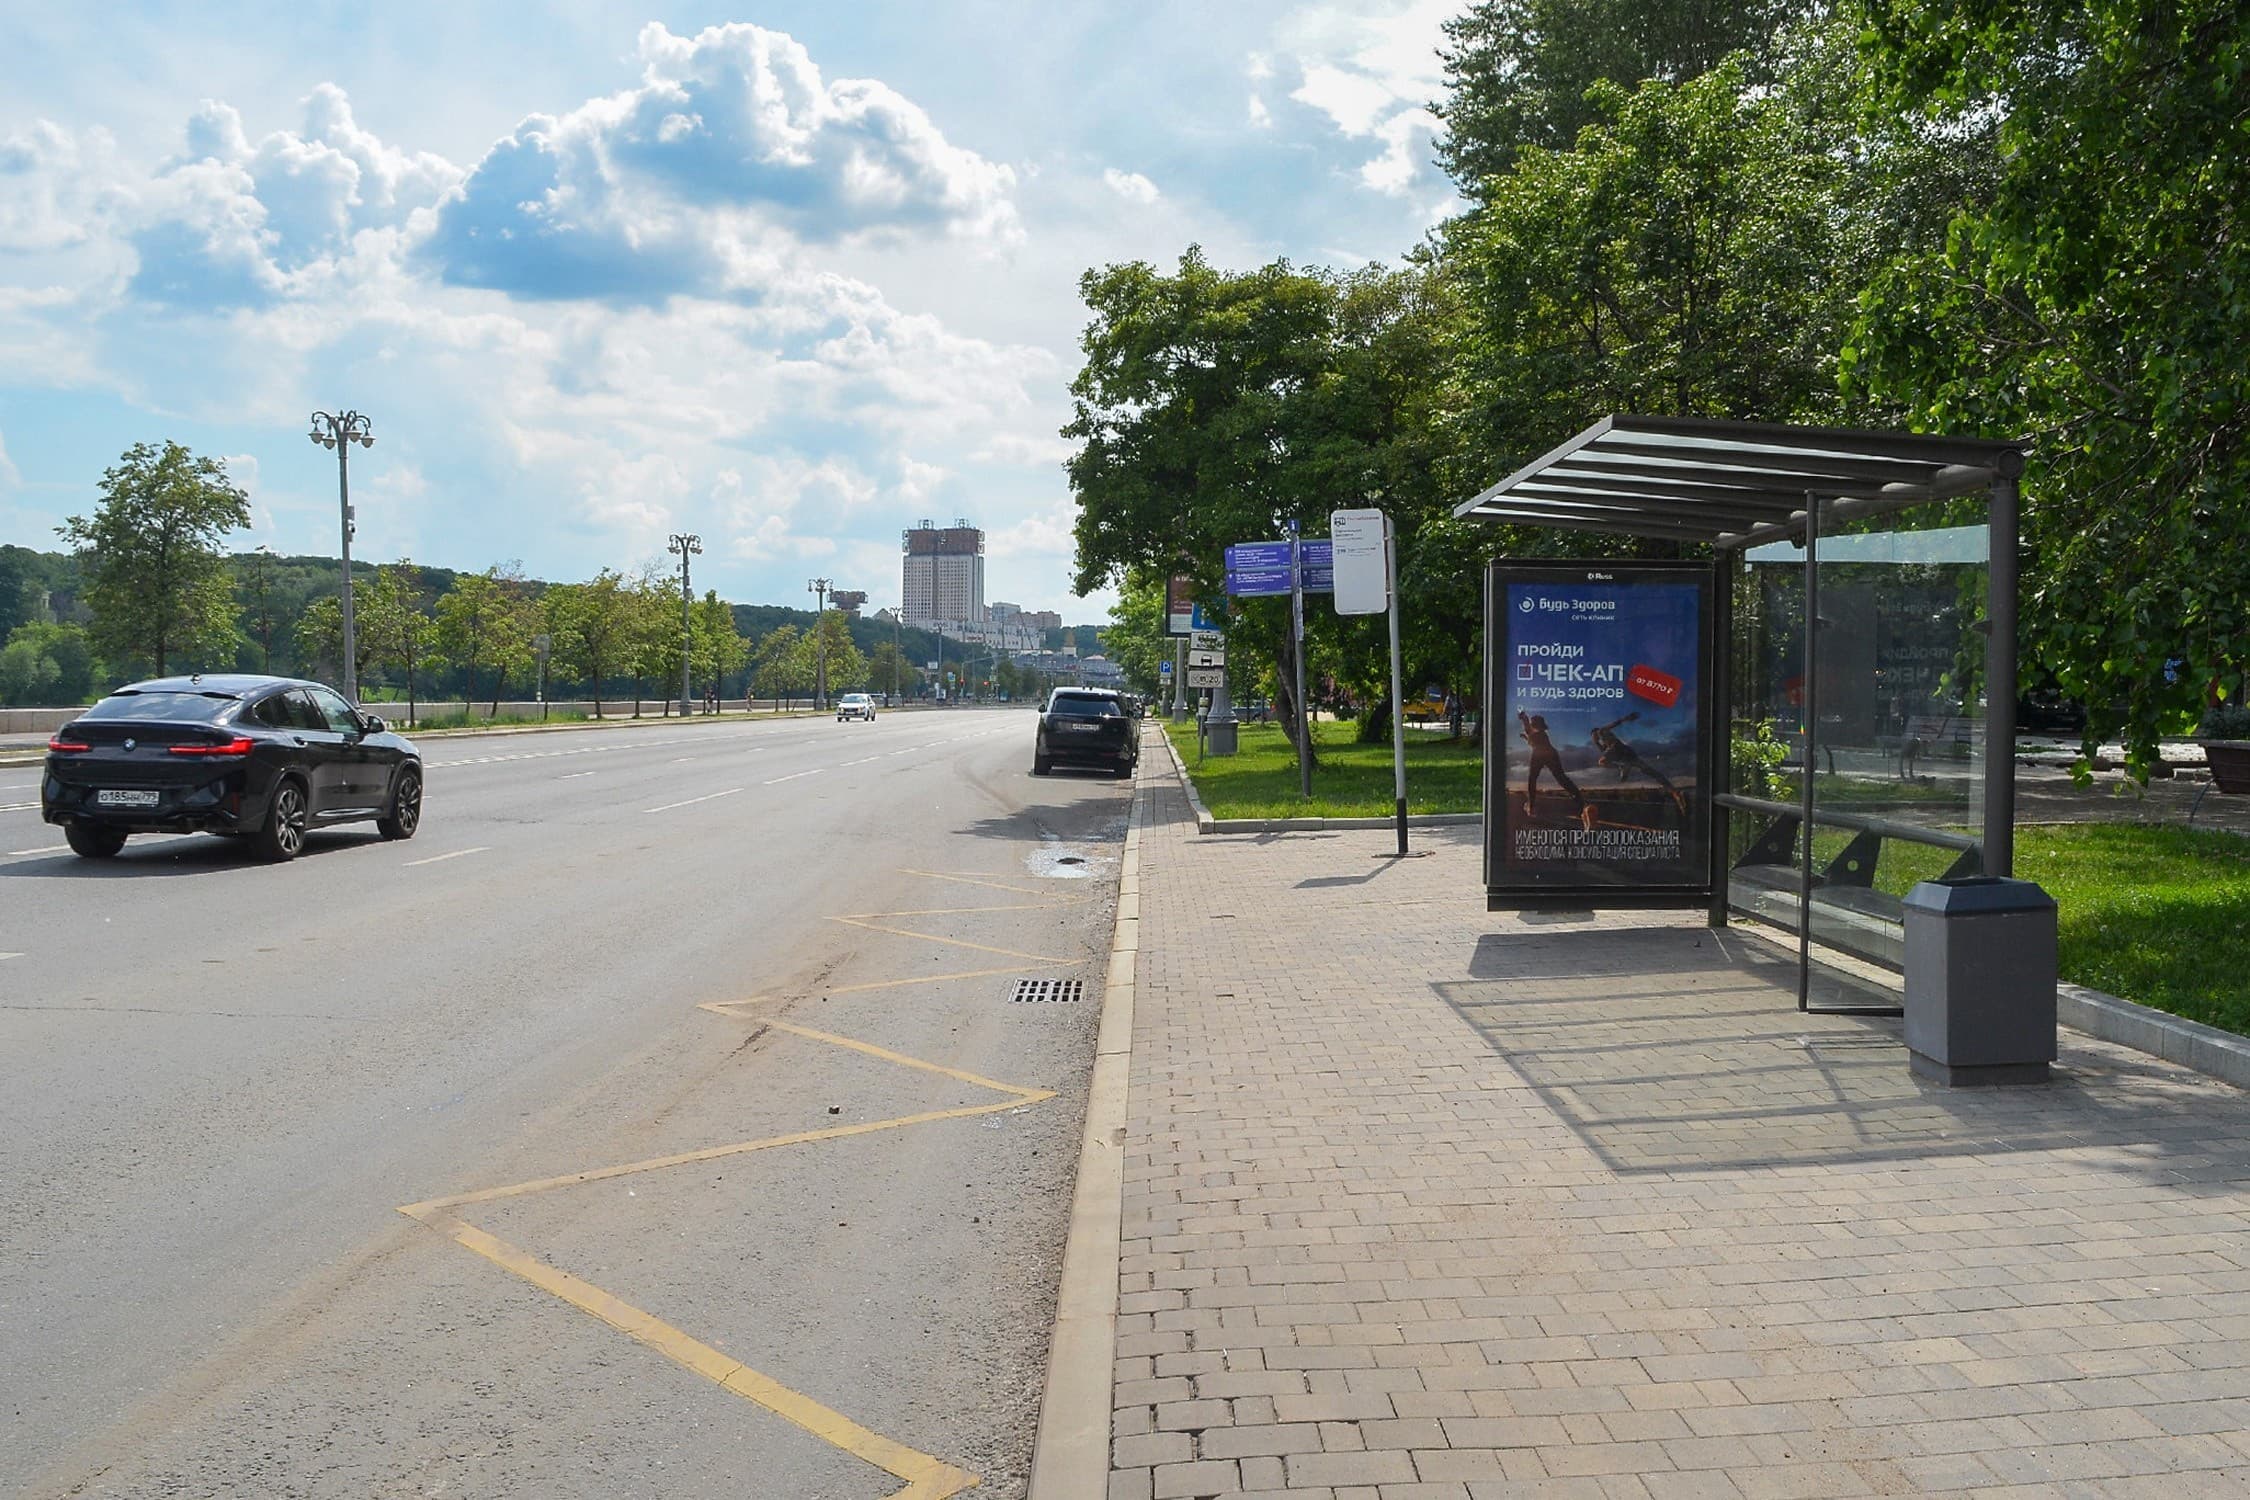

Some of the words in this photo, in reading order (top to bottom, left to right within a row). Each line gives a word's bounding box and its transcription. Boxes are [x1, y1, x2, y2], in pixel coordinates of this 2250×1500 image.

[1539, 598, 1569, 612] Будь
[1571, 599, 1615, 612] Здоров
[1517, 642, 1584, 659] ПРОЙДИ
[1537, 664, 1624, 681] ЧЕК-АП
[1517, 688, 1527, 697] И
[1530, 688, 1565, 699] БУДЬ
[1568, 687, 1624, 699] ЗДОРОВ
[1515, 829, 1568, 845] ИМЕЮТСЯ
